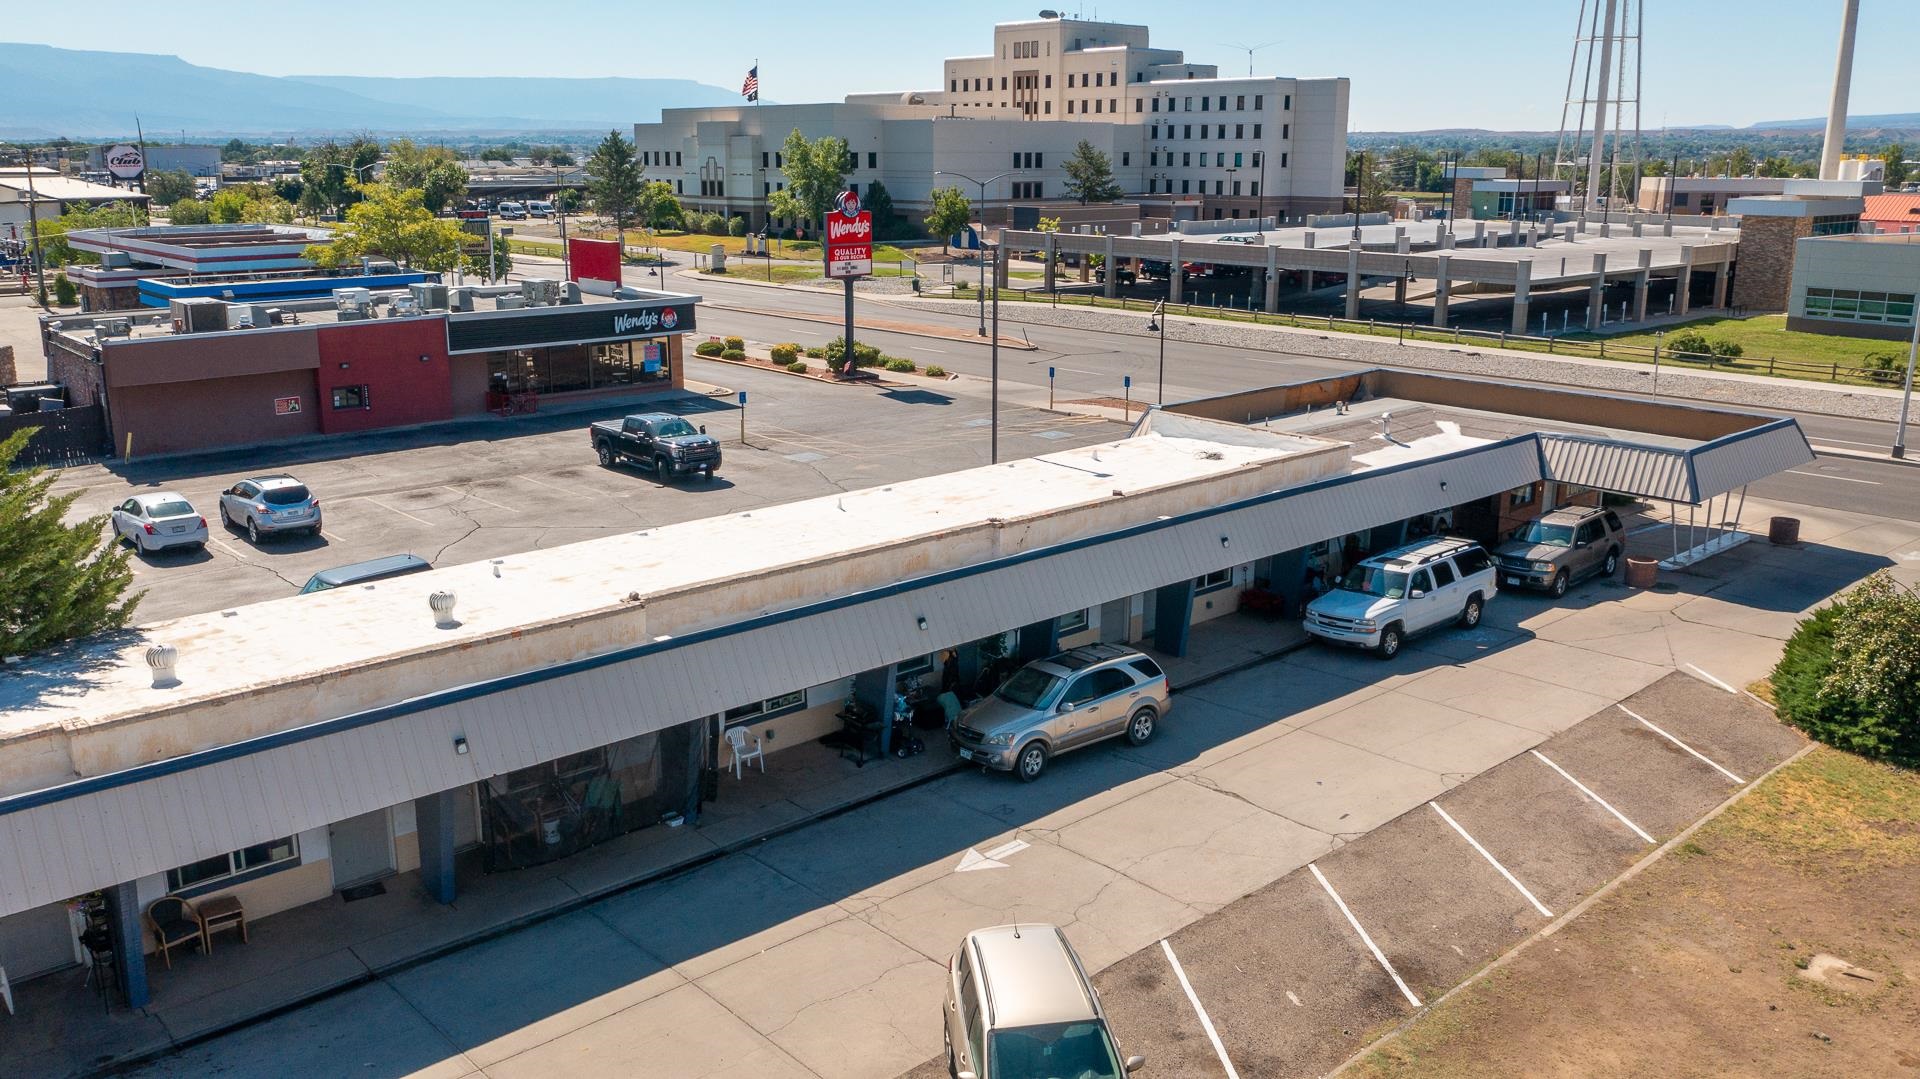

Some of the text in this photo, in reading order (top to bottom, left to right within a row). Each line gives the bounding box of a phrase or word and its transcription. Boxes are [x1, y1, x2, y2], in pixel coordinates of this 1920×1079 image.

[110, 157, 141, 165] Club
[830, 217, 869, 239] Wendy's
[834, 248, 866, 256] QUALITY
[614, 310, 658, 333] Wendy's
